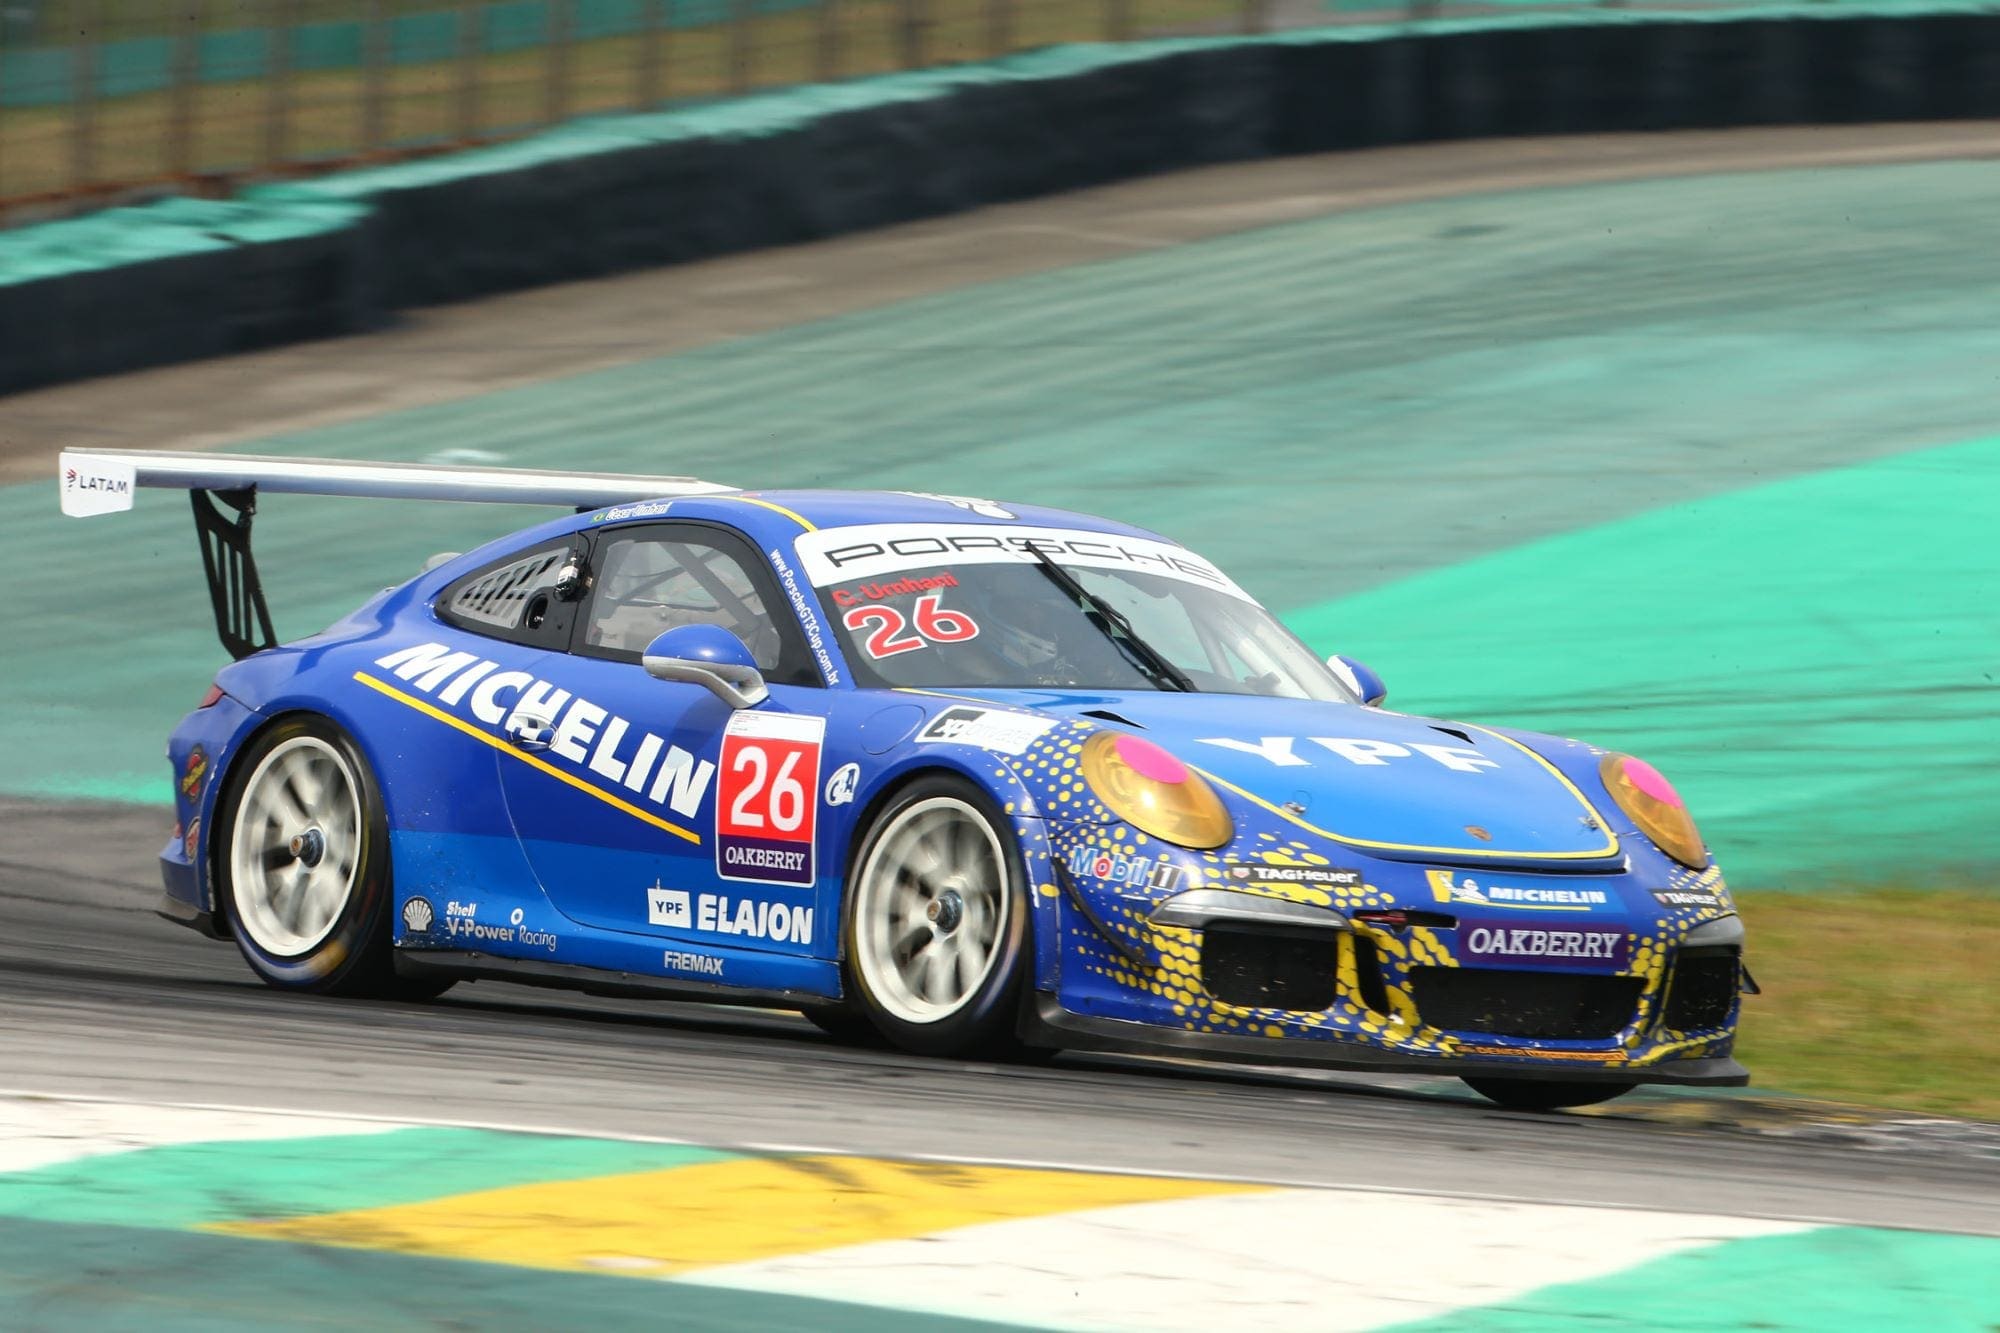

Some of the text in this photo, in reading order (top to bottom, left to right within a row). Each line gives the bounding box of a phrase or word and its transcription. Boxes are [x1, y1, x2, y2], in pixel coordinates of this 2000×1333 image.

[80, 476, 128, 494] LATAM
[825, 537, 1226, 585] PORSCHE
[831, 589, 863, 607] C.
[769, 549, 840, 686] www.PorscheGT3Cup.com.br
[843, 595, 980, 659] 26
[374, 642, 716, 819] MICHELIN
[1193, 737, 1501, 774] YPF
[731, 746, 804, 832] 26
[725, 846, 805, 871] OAKBERRY
[1070, 846, 1152, 886] Mobil
[446, 901, 477, 917] Shell
[1489, 887, 1607, 904] MICHELIN
[446, 917, 557, 952] V-Power Racing
[656, 893, 813, 945] YPF ELAION
[1468, 928, 1622, 958] OAKBERRY
[664, 951, 724, 976] FREMAX
